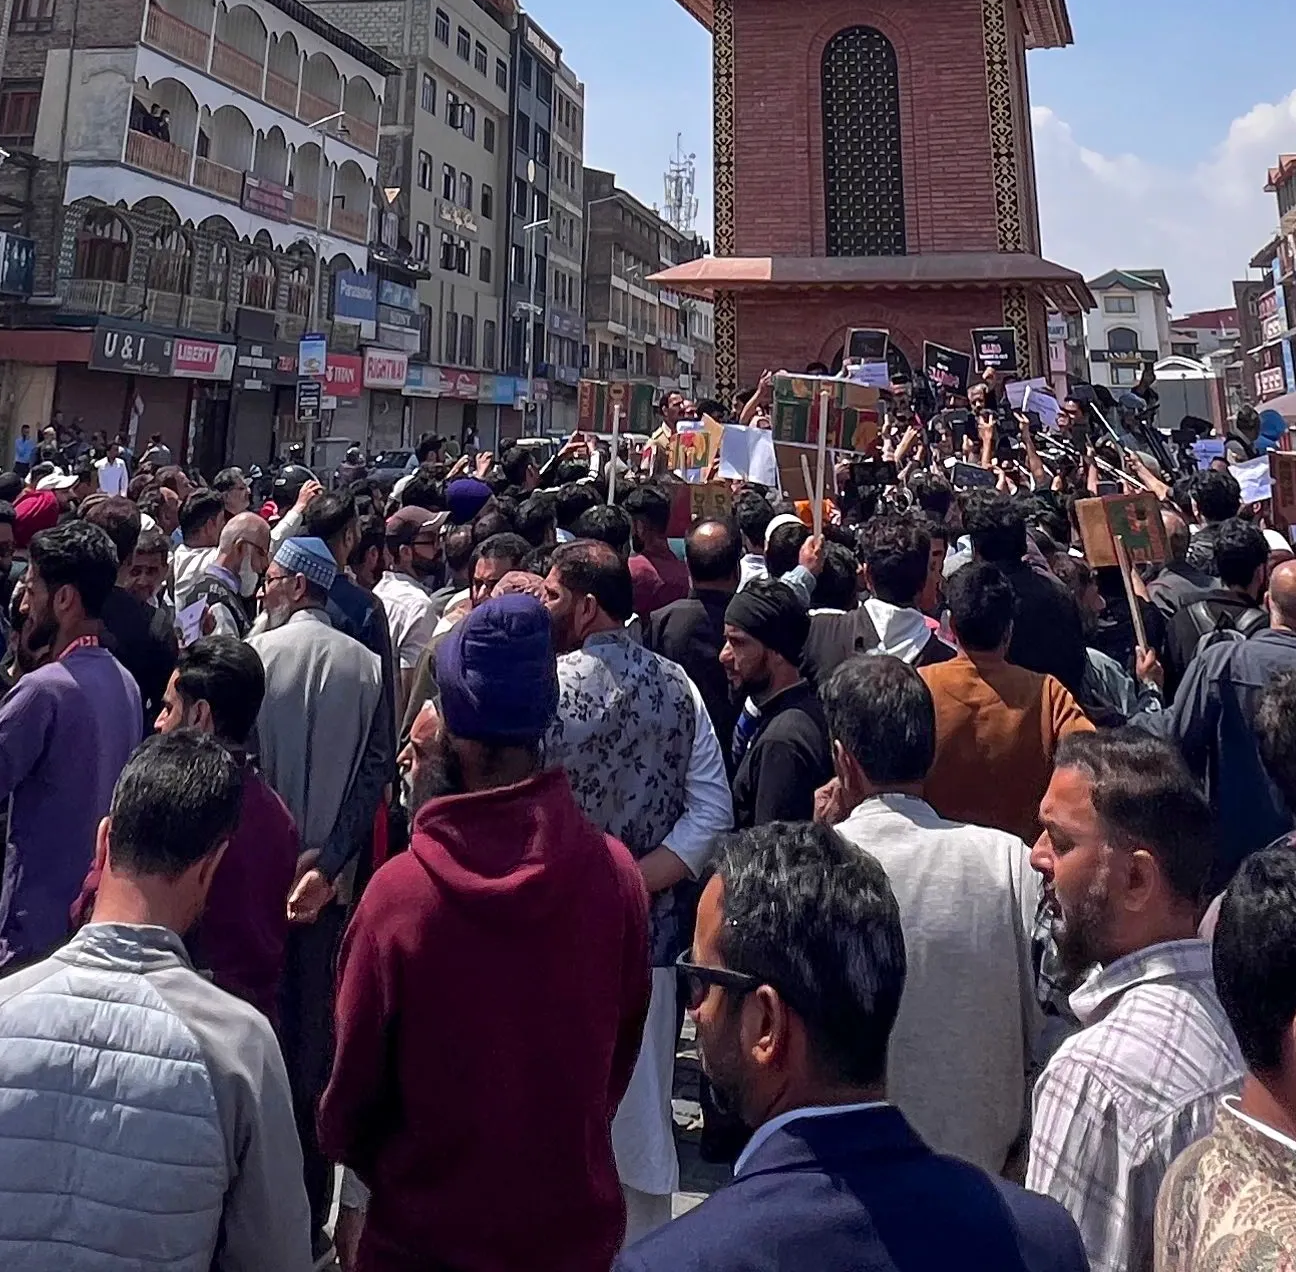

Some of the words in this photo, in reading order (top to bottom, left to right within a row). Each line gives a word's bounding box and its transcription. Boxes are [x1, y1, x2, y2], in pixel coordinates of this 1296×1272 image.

[105, 332, 119, 358] U
[177, 343, 216, 363] LIBERTY
[334, 367, 355, 384] TITAN
